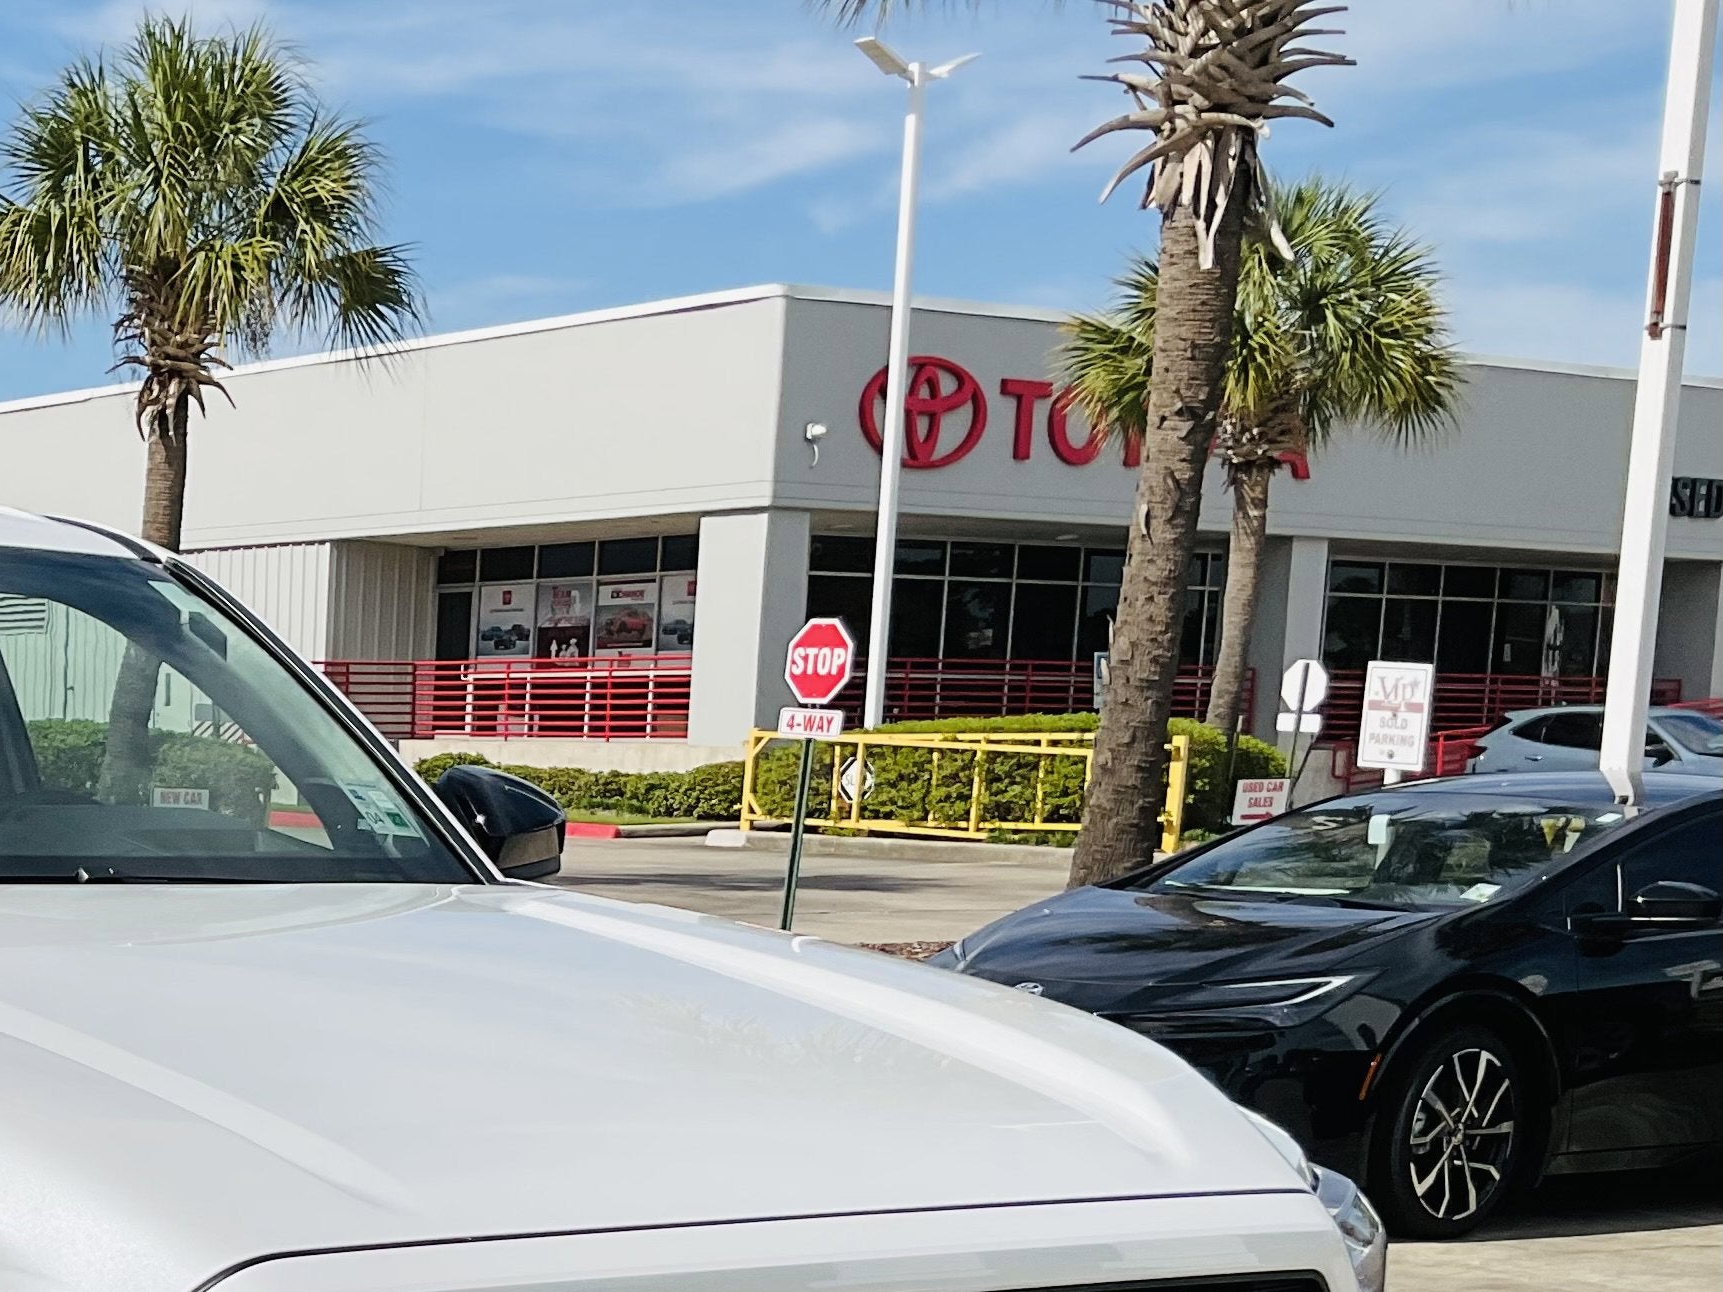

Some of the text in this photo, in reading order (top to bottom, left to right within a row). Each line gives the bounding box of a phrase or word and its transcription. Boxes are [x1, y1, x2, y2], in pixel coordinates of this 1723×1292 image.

[1670, 475, 1723, 518] SED
[791, 647, 845, 675] STOP
[787, 714, 834, 733] 4-WAY
[1380, 717, 1408, 729] SOLD
[1368, 733, 1414, 747] PARKING
[1242, 781, 1284, 793] USED CAR
[160, 791, 203, 805] NEW CAR
[1248, 797, 1273, 808] SALES
